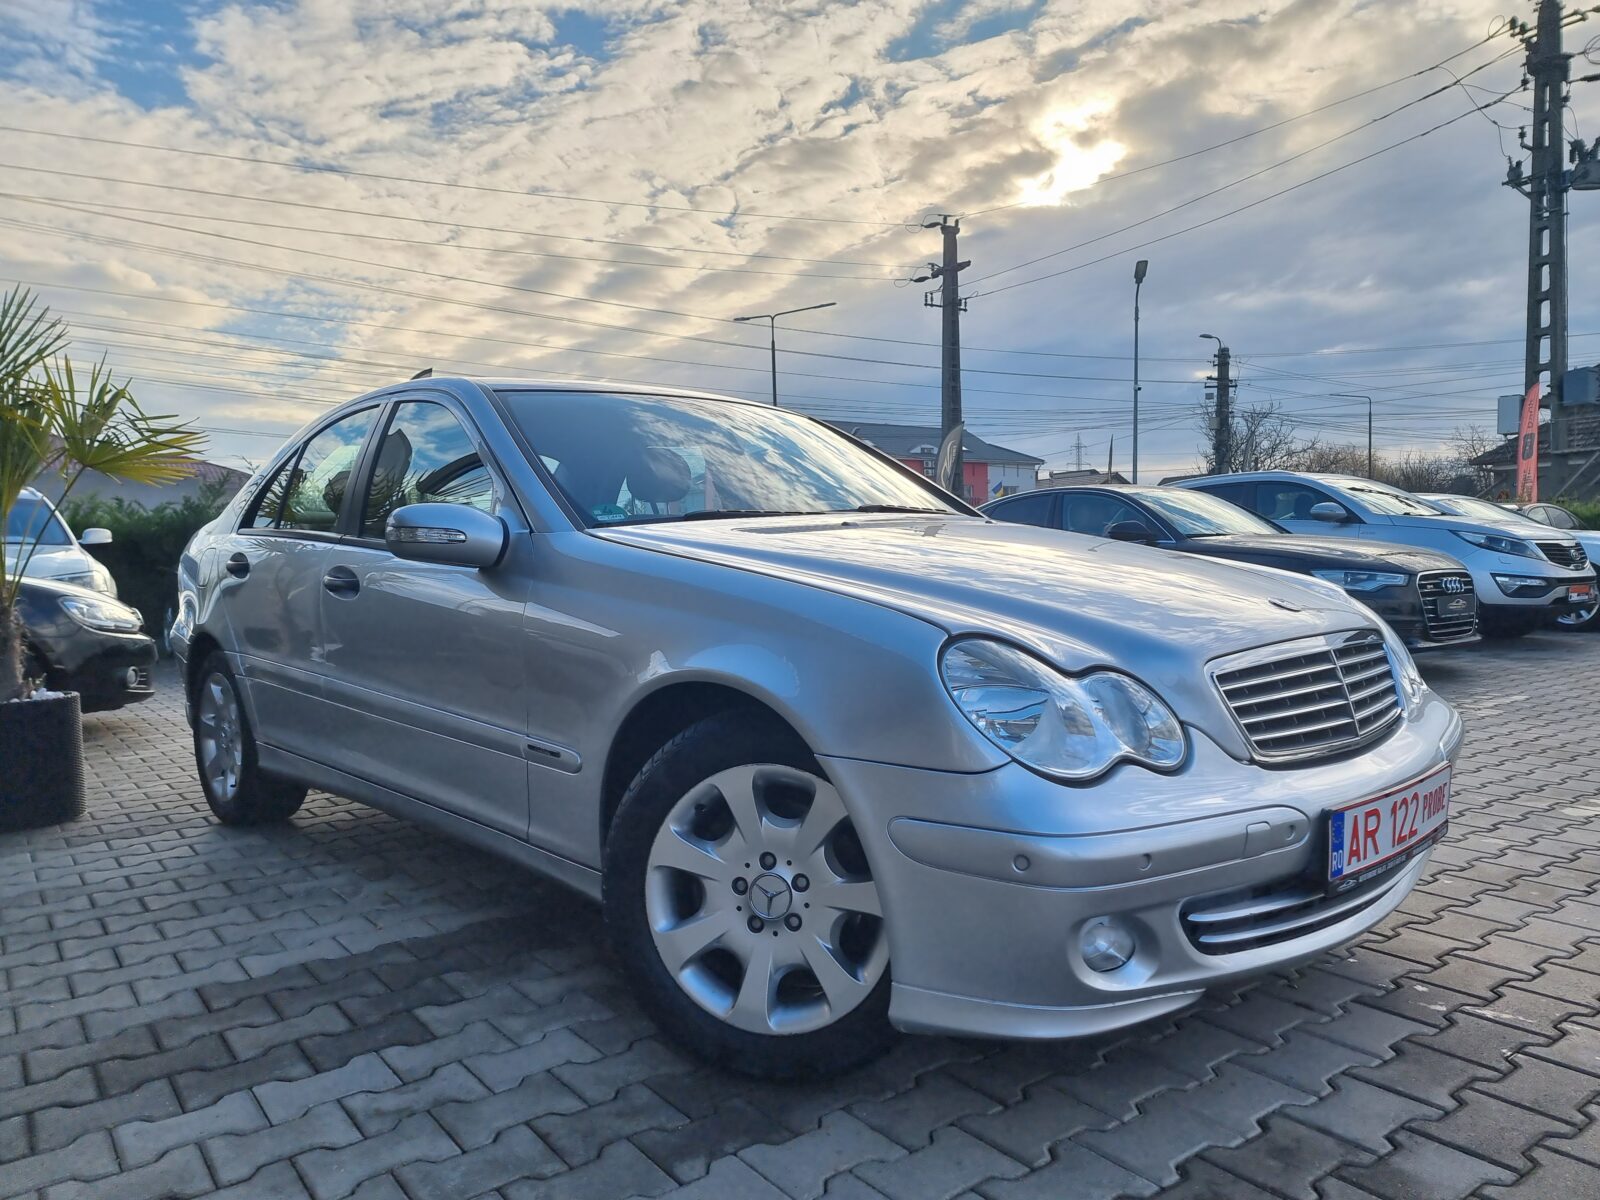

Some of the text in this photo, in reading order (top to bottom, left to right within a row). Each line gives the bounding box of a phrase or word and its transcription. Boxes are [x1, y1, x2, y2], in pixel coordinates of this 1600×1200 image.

[1347, 782, 1448, 866] AR 122 PROBE
[1331, 850, 1344, 872] RO
